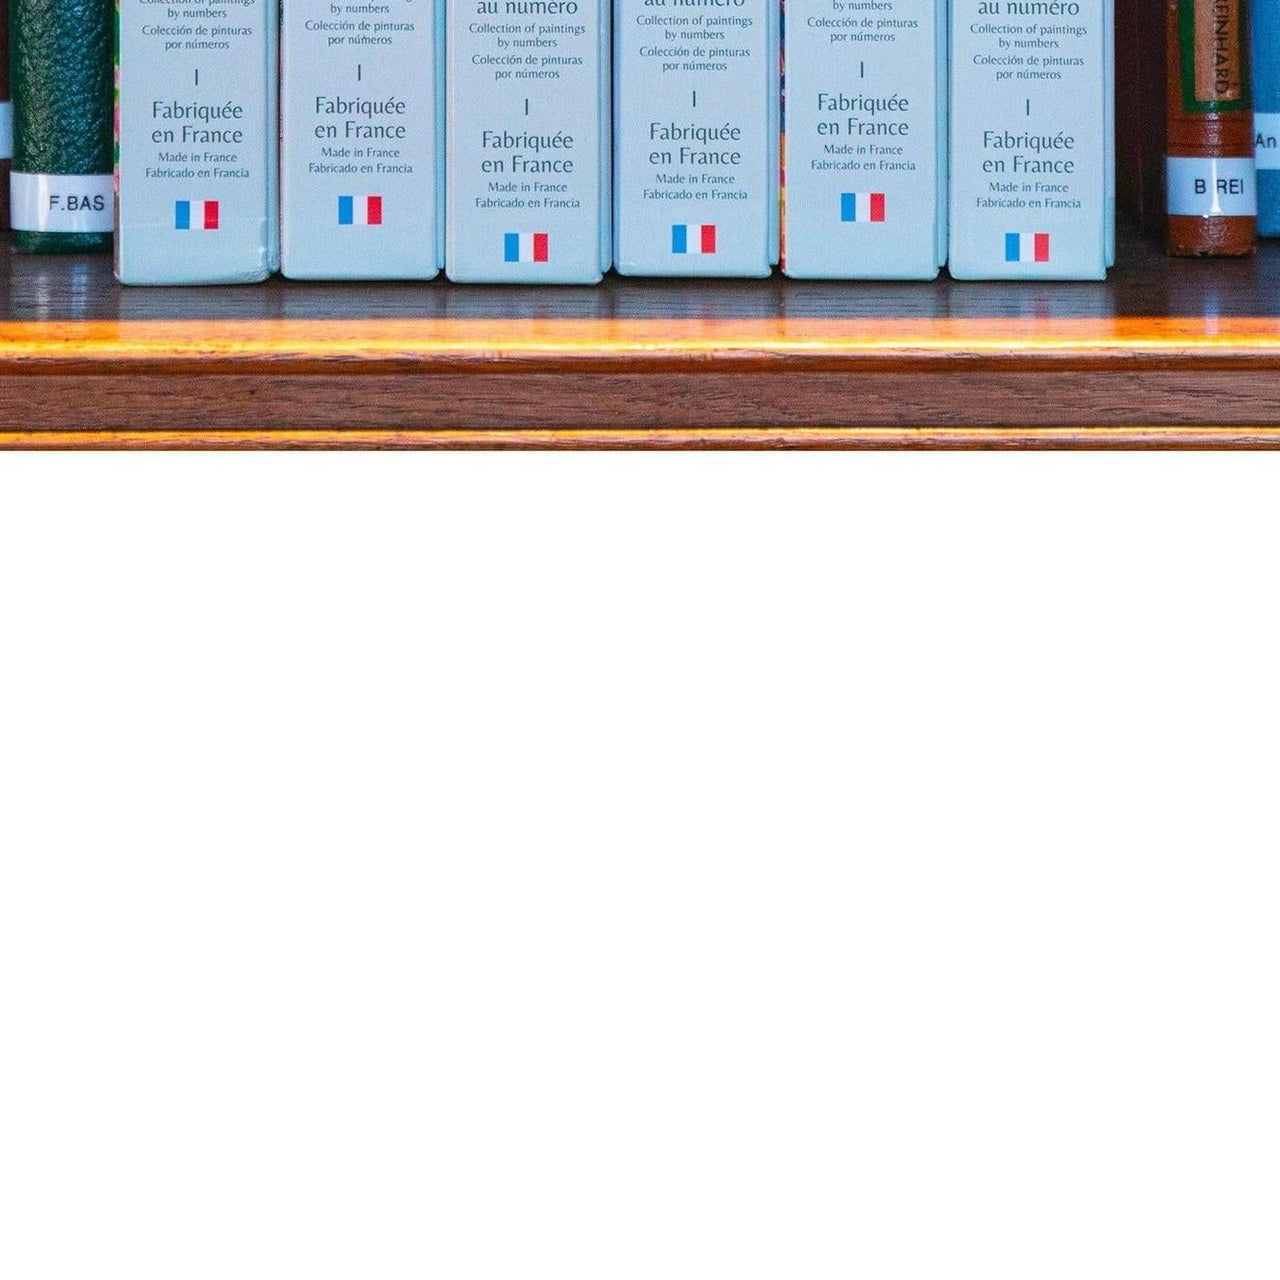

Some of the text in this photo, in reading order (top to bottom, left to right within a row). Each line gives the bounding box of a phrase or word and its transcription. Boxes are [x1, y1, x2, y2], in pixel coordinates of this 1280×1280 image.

[482, 129, 577, 153] Fabriquée
[1255, 133, 1277, 148] An
[480, 154, 577, 174] en France
[988, 181, 1070, 193] Made in France
[1194, 179, 1245, 195] B REI
[48, 194, 106, 213] F.BAS
[976, 196, 1082, 209] Fabricado en Francia
